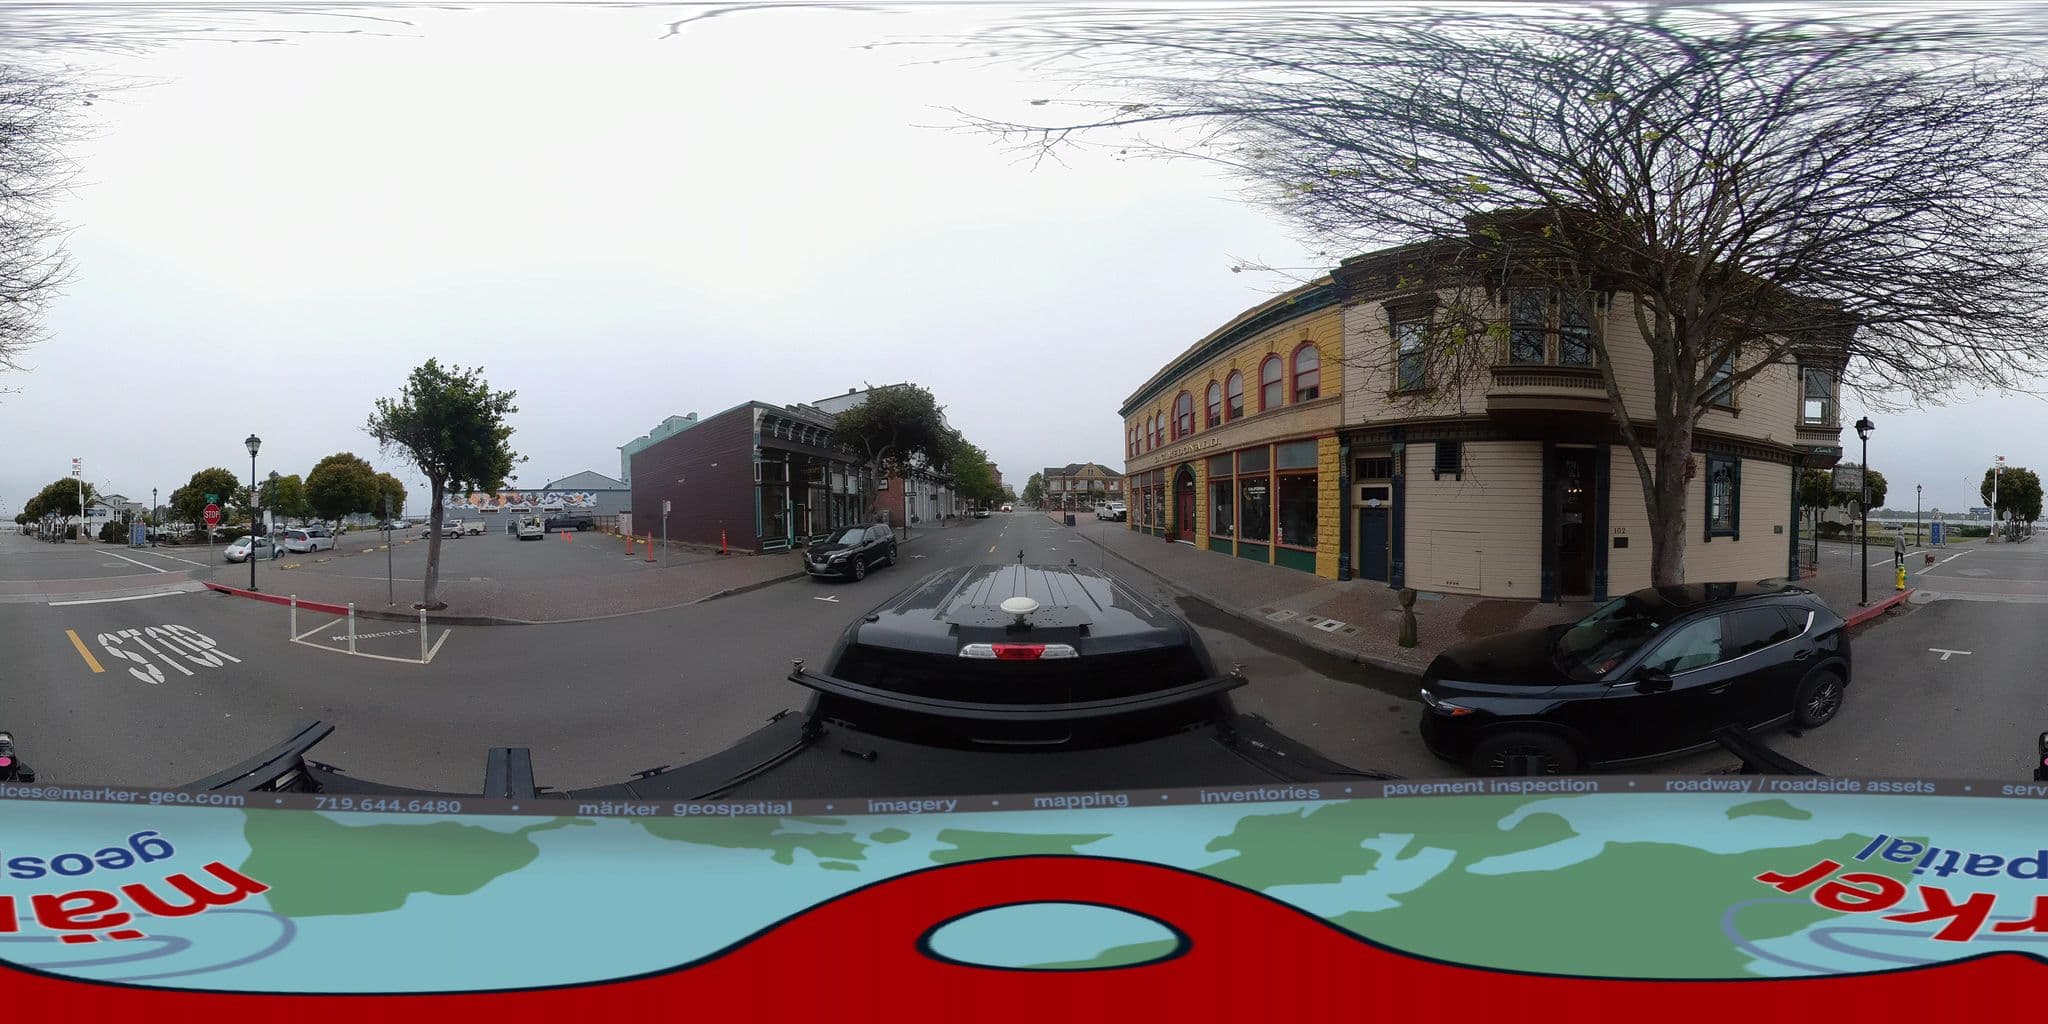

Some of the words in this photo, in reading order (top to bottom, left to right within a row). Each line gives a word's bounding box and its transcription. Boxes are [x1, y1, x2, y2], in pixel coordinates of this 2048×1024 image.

[204, 510, 220, 519] STOP
[332, 628, 418, 641] MOTORCYCLE
[97, 624, 242, 684] STOP
